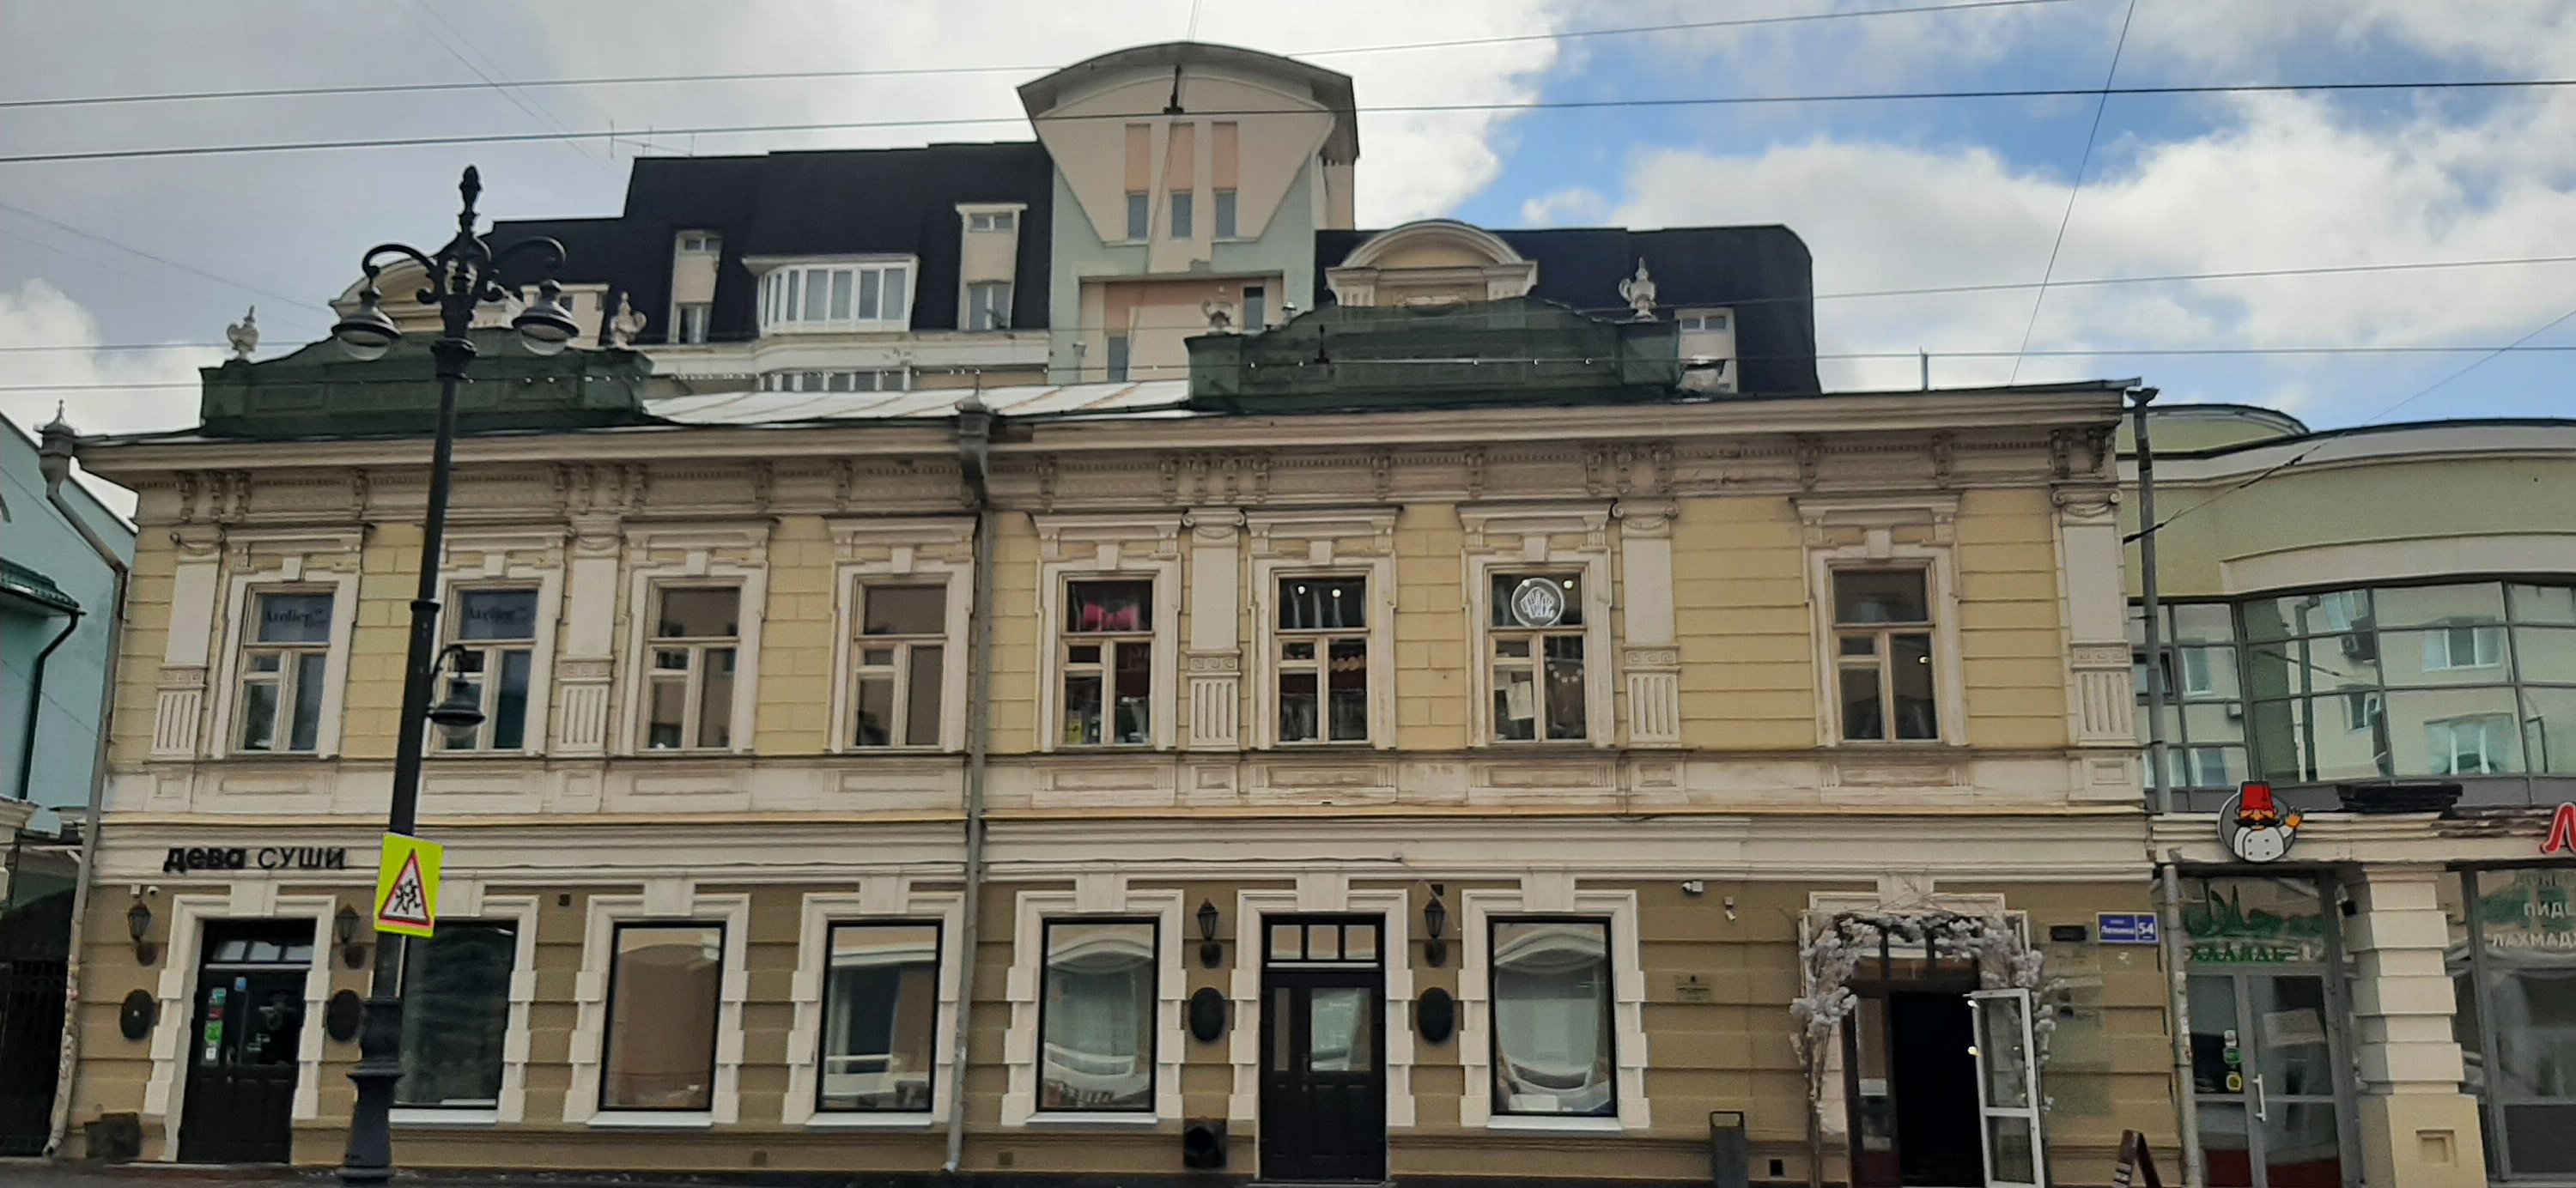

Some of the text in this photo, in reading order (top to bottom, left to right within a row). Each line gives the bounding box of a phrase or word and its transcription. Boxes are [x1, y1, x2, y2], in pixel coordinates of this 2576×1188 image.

[162, 846, 345, 872] дева СУШИ
[2138, 922, 2154, 935] 54
